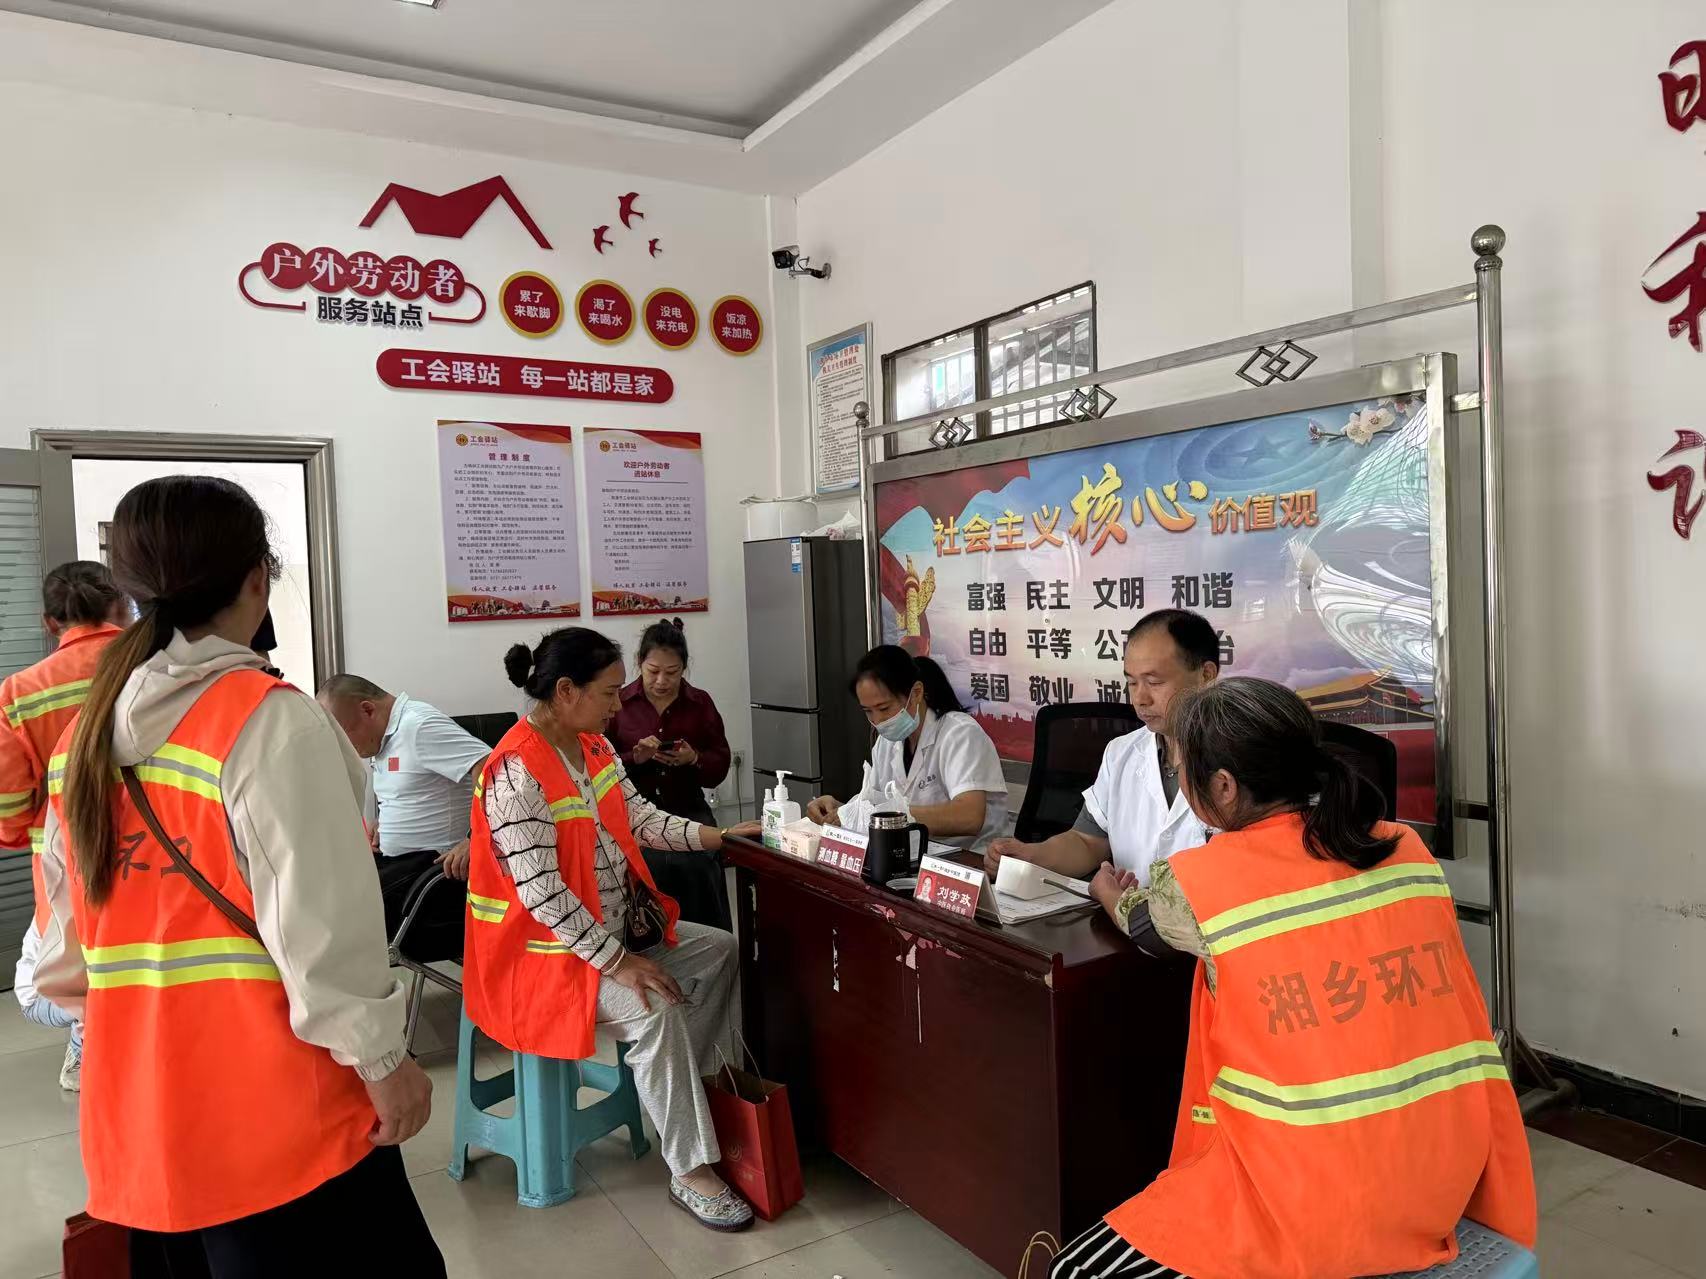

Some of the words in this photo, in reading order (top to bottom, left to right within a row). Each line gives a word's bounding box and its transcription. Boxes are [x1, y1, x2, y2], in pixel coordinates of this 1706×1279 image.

[269, 248, 459, 298] 户外劳动者
[520, 289, 543, 303] 累了
[593, 297, 616, 311] 渴了
[317, 296, 424, 328] 服务站点
[514, 304, 551, 319] 来歇脚
[660, 305, 682, 319] 没电
[588, 312, 623, 326] 来喝水
[656, 319, 689, 333] 来充电
[725, 312, 747, 326] 饭凉
[721, 326, 753, 340] 来加热
[400, 358, 501, 386] 工会驿站
[520, 364, 655, 396] 每一站都是家
[470, 435, 498, 444] 工会驿站
[611, 442, 637, 450] 工会驿站
[488, 452, 531, 462] 管理制度
[623, 460, 671, 470] 欢迎户外劳动者
[633, 470, 661, 478] 进站休息
[934, 462, 1319, 557] 社会主义核心价值观
[967, 582, 1006, 611] 富强
[1026, 580, 1071, 610] 民主
[1093, 577, 1144, 610] 文明
[1171, 572, 1233, 609] 和谐
[969, 628, 1007, 656] 自由
[1027, 628, 1072, 659] 平等
[1095, 629, 1128, 661] 公
[970, 672, 1010, 702] 爱国
[1029, 676, 1074, 705] 敬业
[1095, 678, 1130, 704] 诚
